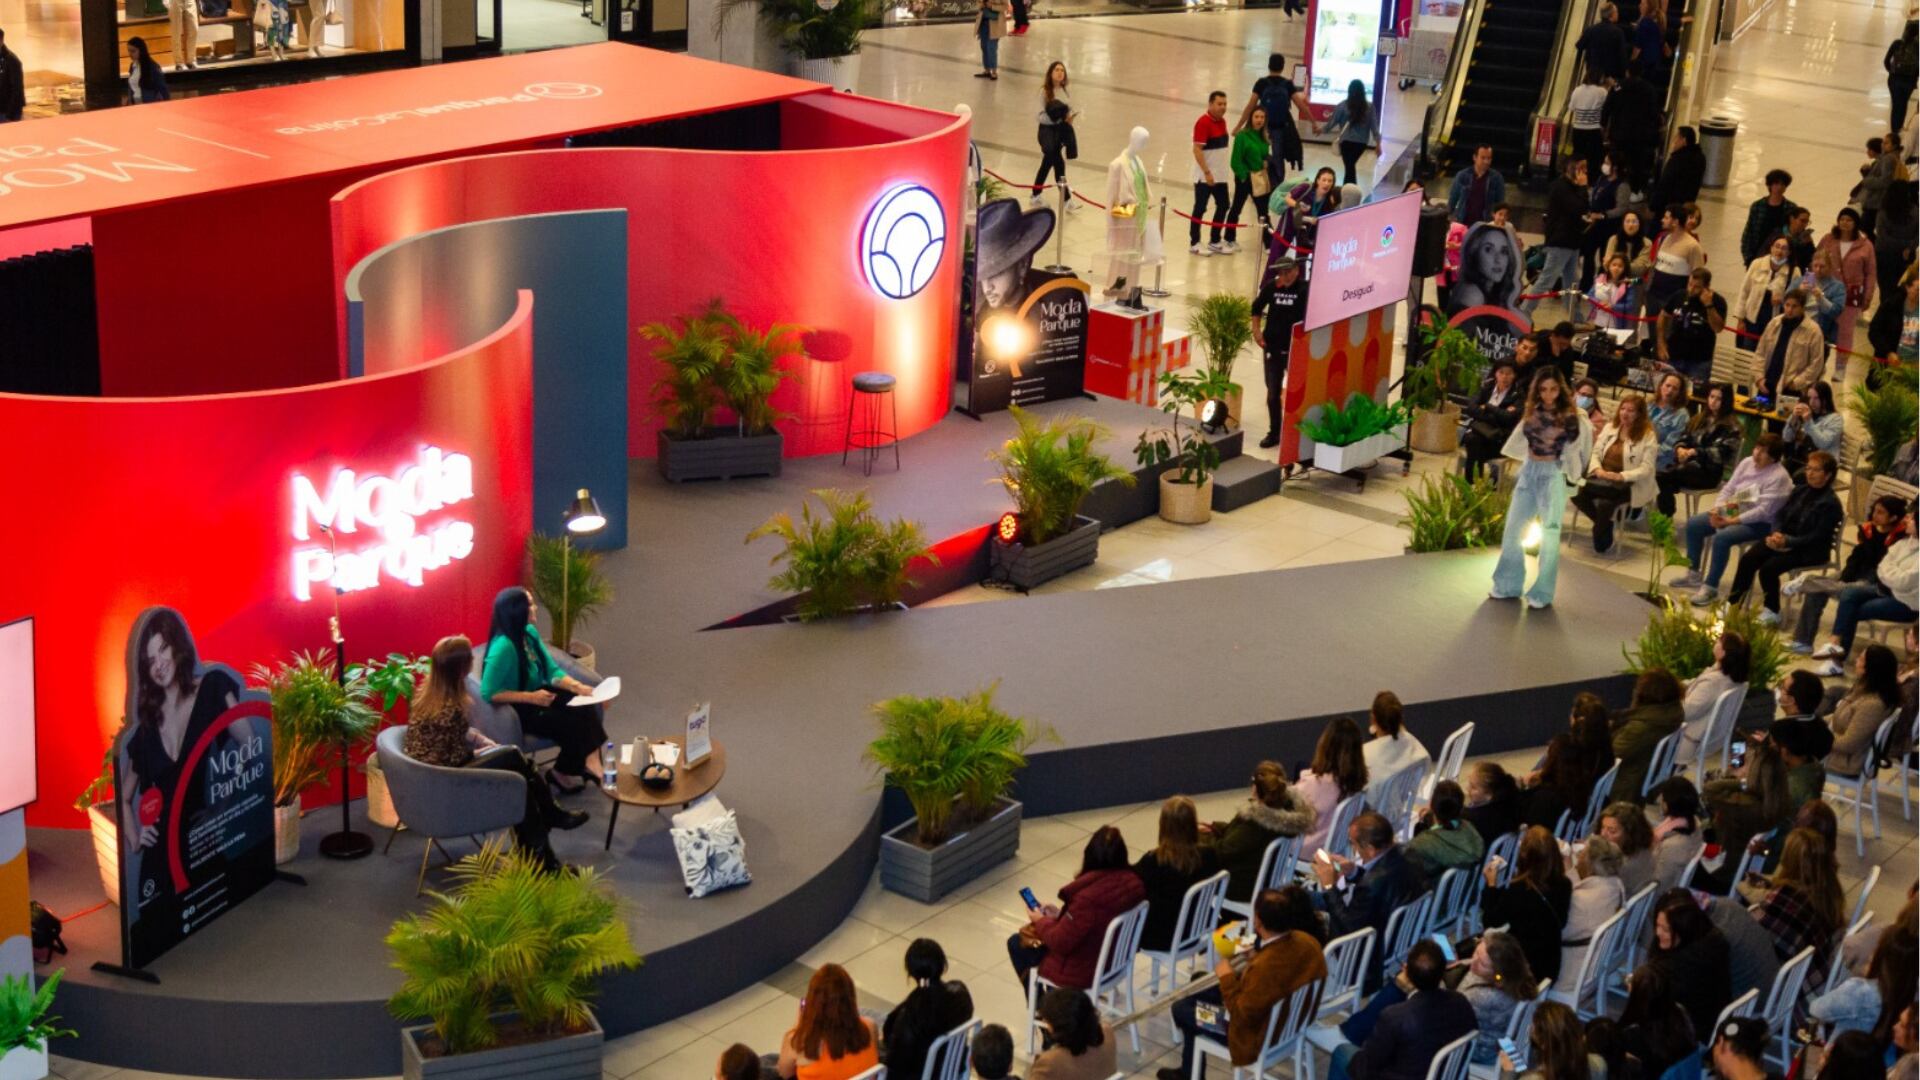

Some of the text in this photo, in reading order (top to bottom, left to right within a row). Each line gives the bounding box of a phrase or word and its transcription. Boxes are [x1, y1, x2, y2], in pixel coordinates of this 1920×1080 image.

[1331, 236, 1358, 256] Moda
[1040, 298, 1082, 317] Moda
[1040, 317, 1081, 333] Parque
[1475, 325, 1518, 350] Moda
[292, 444, 474, 541] Moda
[292, 521, 474, 602] Parque
[209, 735, 263, 780] Moda
[210, 762, 264, 805] Parque
